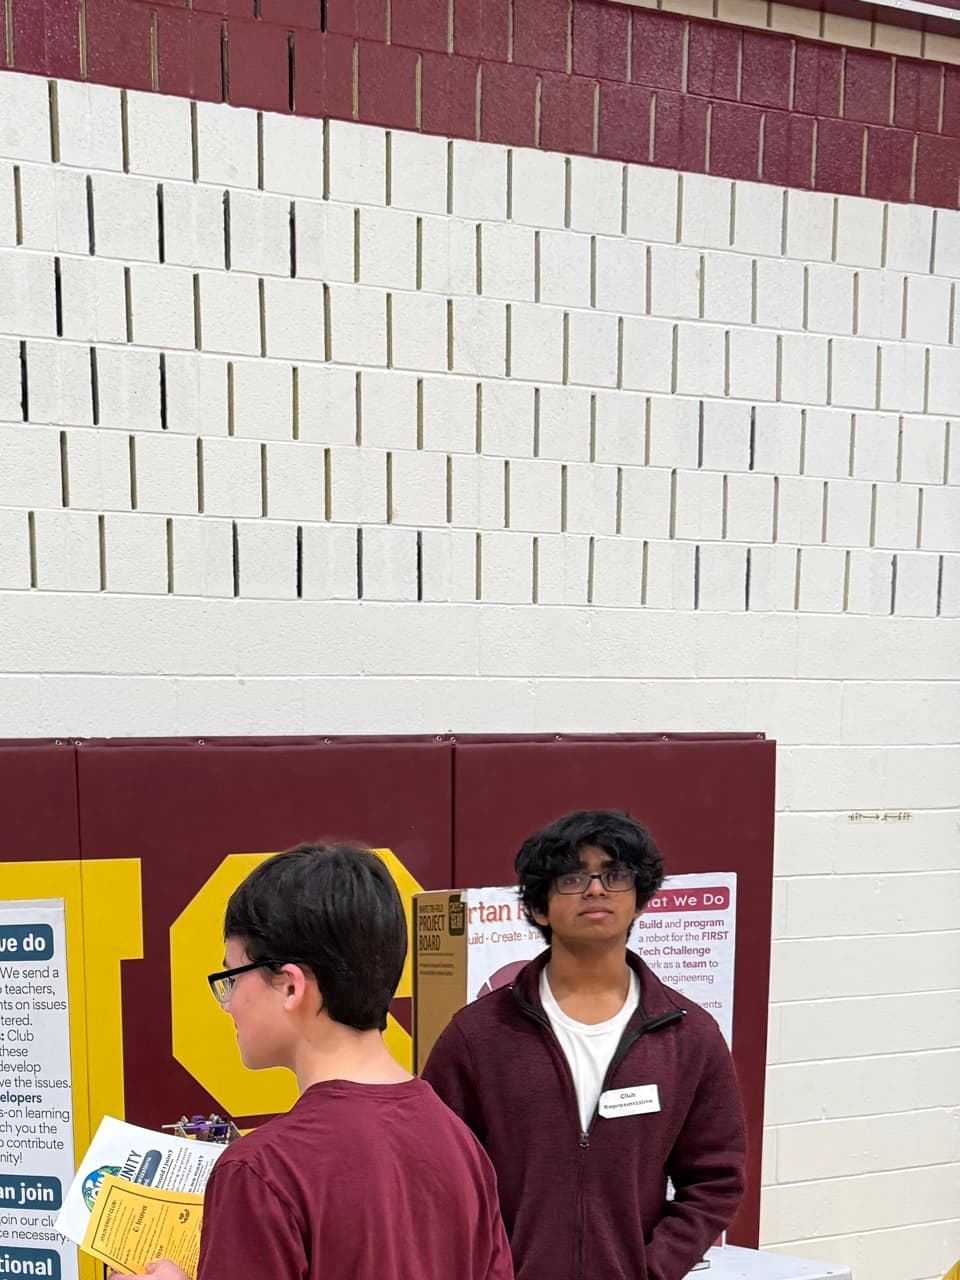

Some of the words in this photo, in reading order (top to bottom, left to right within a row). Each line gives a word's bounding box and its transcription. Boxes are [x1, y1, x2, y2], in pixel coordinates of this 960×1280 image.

[673, 895, 697, 906] We
[703, 893, 725, 905] Do
[468, 901, 512, 924] rtan
[639, 920, 662, 930] Build
[664, 919, 682, 929] and
[683, 920, 725, 931] program
[22, 933, 46, 951] do
[468, 932, 484, 944] uild
[490, 930, 522, 943] Create
[645, 933, 670, 943] robot
[671, 932, 684, 942] for
[685, 932, 700, 942] the
[701, 930, 729, 941] FIRST
[638, 946, 661, 956] Tech
[662, 946, 711, 957] Challenge
[648, 960, 662, 969] ork
[663, 961, 674, 969] as
[682, 960, 707, 969] team
[709, 960, 719, 968] to
[0, 967, 20, 978] We
[22, 966, 50, 978] send
[52, 968, 59, 978] a
[662, 974, 714, 984] engineering
[5, 982, 56, 996] teachers,
[15, 1000, 30, 1010] on
[32, 998, 67, 1010] issues
[702, 1000, 723, 1009] ents
[7, 1029, 34, 1041] Club
[14, 1076, 32, 1088] the
[35, 1076, 71, 1088] issues.
[25, 1106, 70, 1123] learning
[15, 1124, 36, 1137] you
[39, 1122, 58, 1135] the
[6, 1137, 64, 1150] contribute
[18, 1182, 54, 1204] join
[20, 1215, 39, 1227] our
